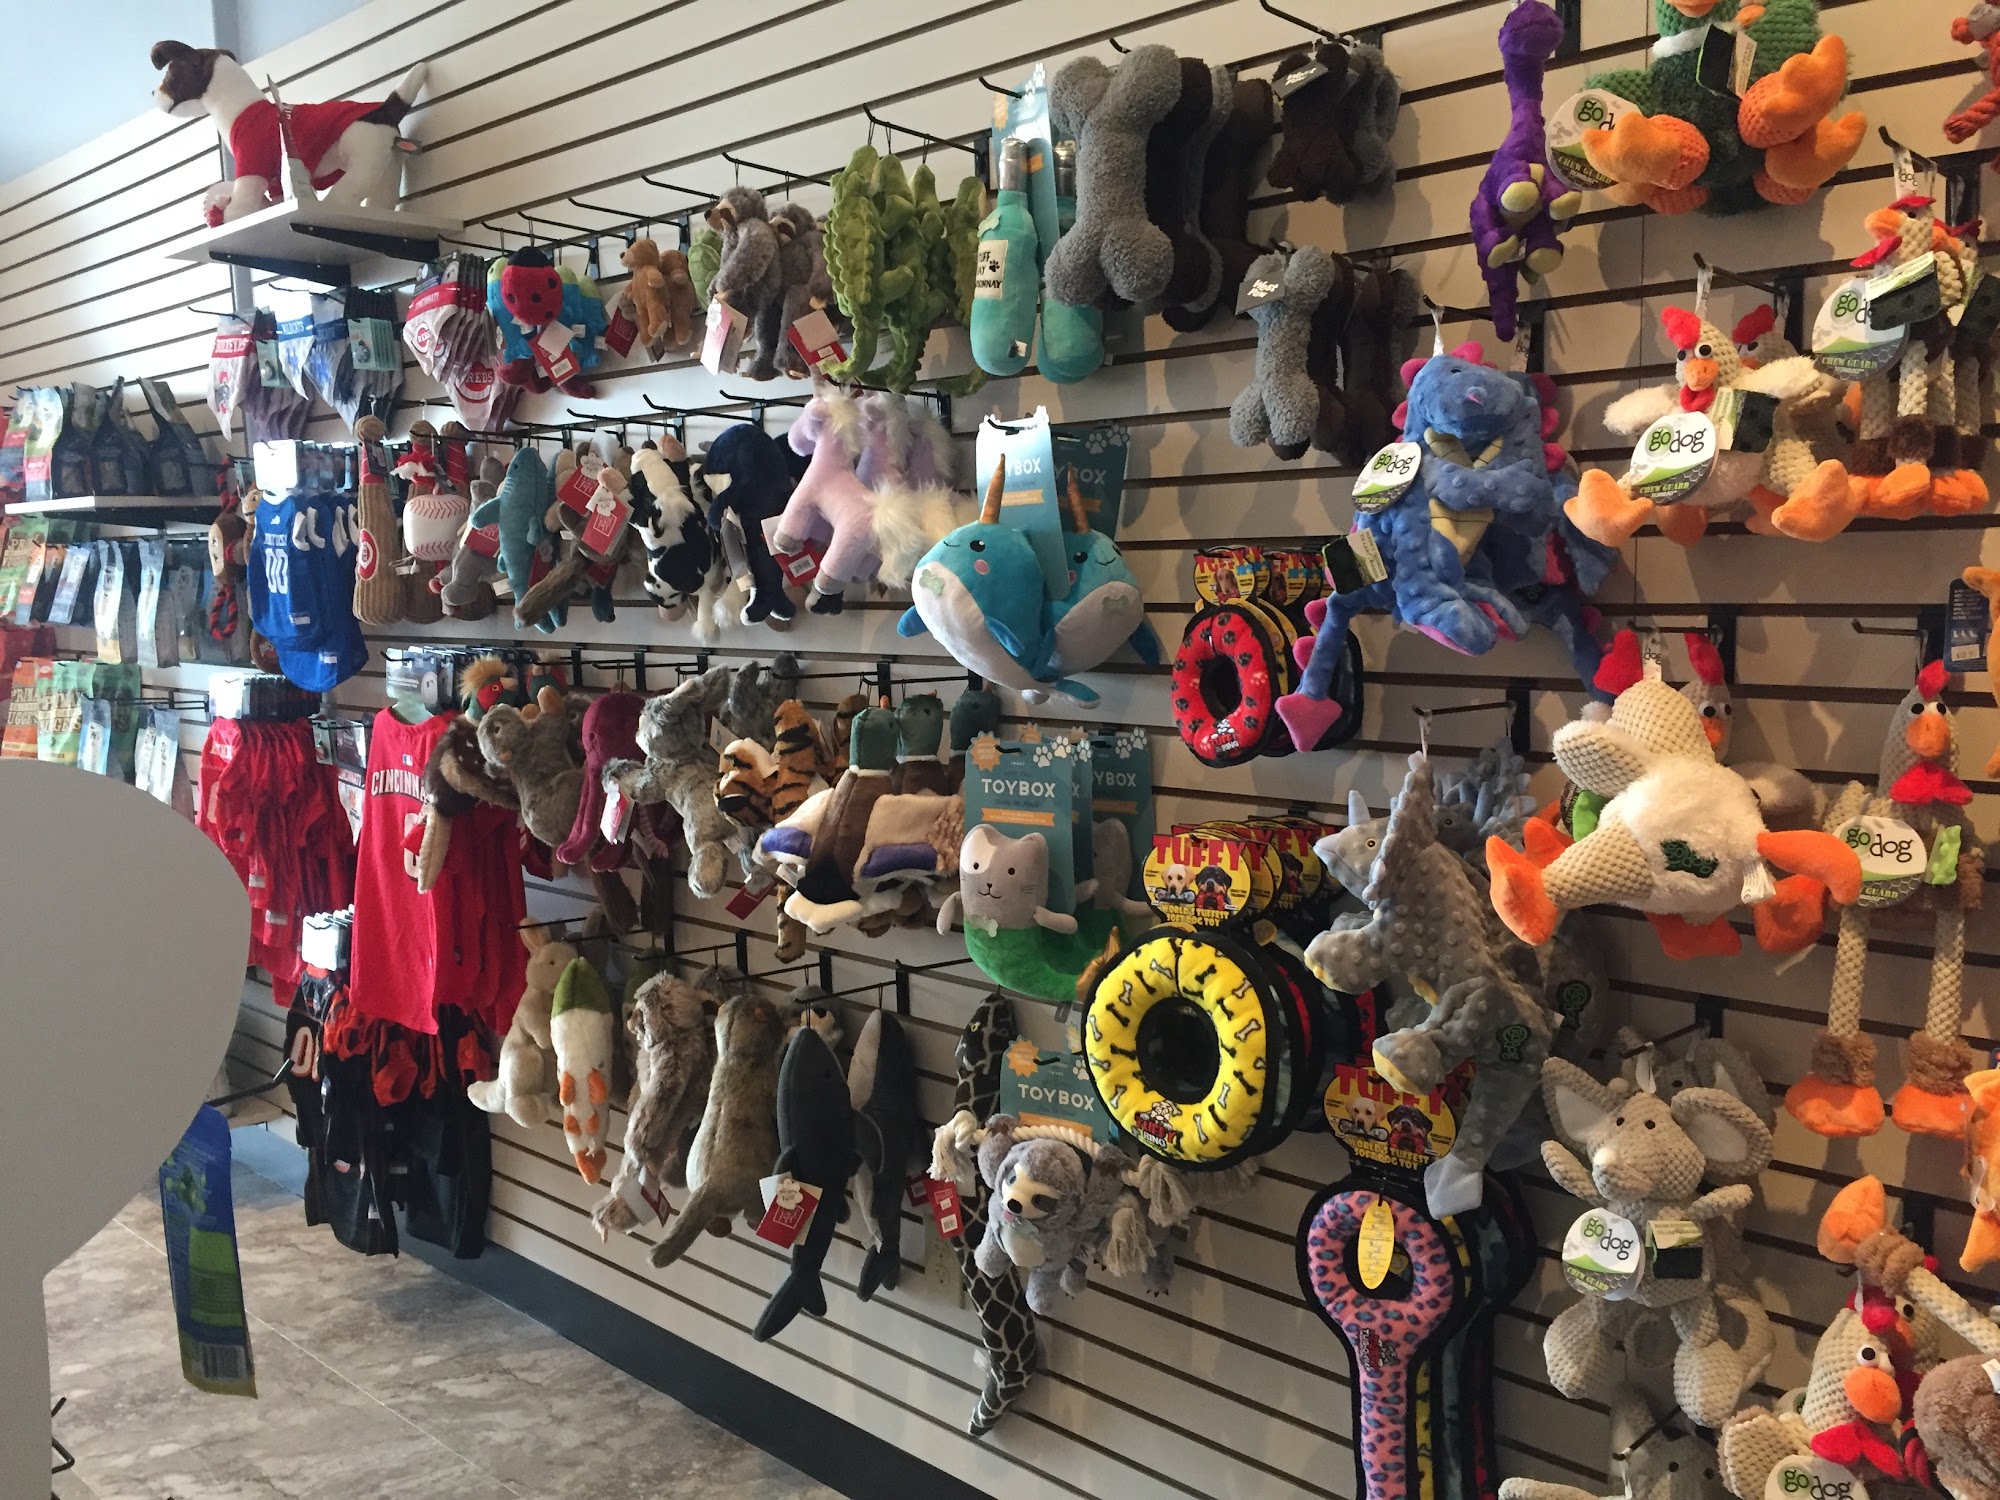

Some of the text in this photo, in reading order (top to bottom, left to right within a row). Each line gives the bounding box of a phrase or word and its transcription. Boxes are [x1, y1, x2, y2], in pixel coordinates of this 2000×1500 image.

[1285, 75, 1307, 86] Paw
[1287, 67, 1317, 81] West
[1578, 100, 1604, 122] go
[1247, 288, 1268, 298] Paw
[1253, 279, 1279, 292] West
[1834, 290, 1858, 317] go
[417, 330, 431, 342] REDS
[465, 371, 494, 385] REDS
[1649, 428, 1707, 453] go dog
[1005, 458, 1041, 476] YBOX
[1374, 453, 1416, 475] go dog
[264, 548, 289, 595] 00
[371, 768, 427, 803] CINCINNA
[981, 778, 1056, 798] TOYBOX
[1094, 771, 1137, 787] YBOX
[1152, 834, 1246, 871] TUFFY
[1846, 827, 1914, 863] go dog
[1865, 887, 1899, 899] GUARD
[1187, 914, 1203, 926] DOG
[1204, 916, 1221, 928] TOY
[1196, 909, 1230, 920] TUFFEST
[1018, 1084, 1095, 1112] TOYBOX
[1143, 1131, 1167, 1148] RING
[1377, 1152, 1397, 1166] DOG
[1398, 1159, 1419, 1171] TOY
[1389, 1147, 1429, 1165] TUFFEST
[1583, 1218, 1634, 1260] go dog
[1784, 1469, 1854, 1500] go dog
